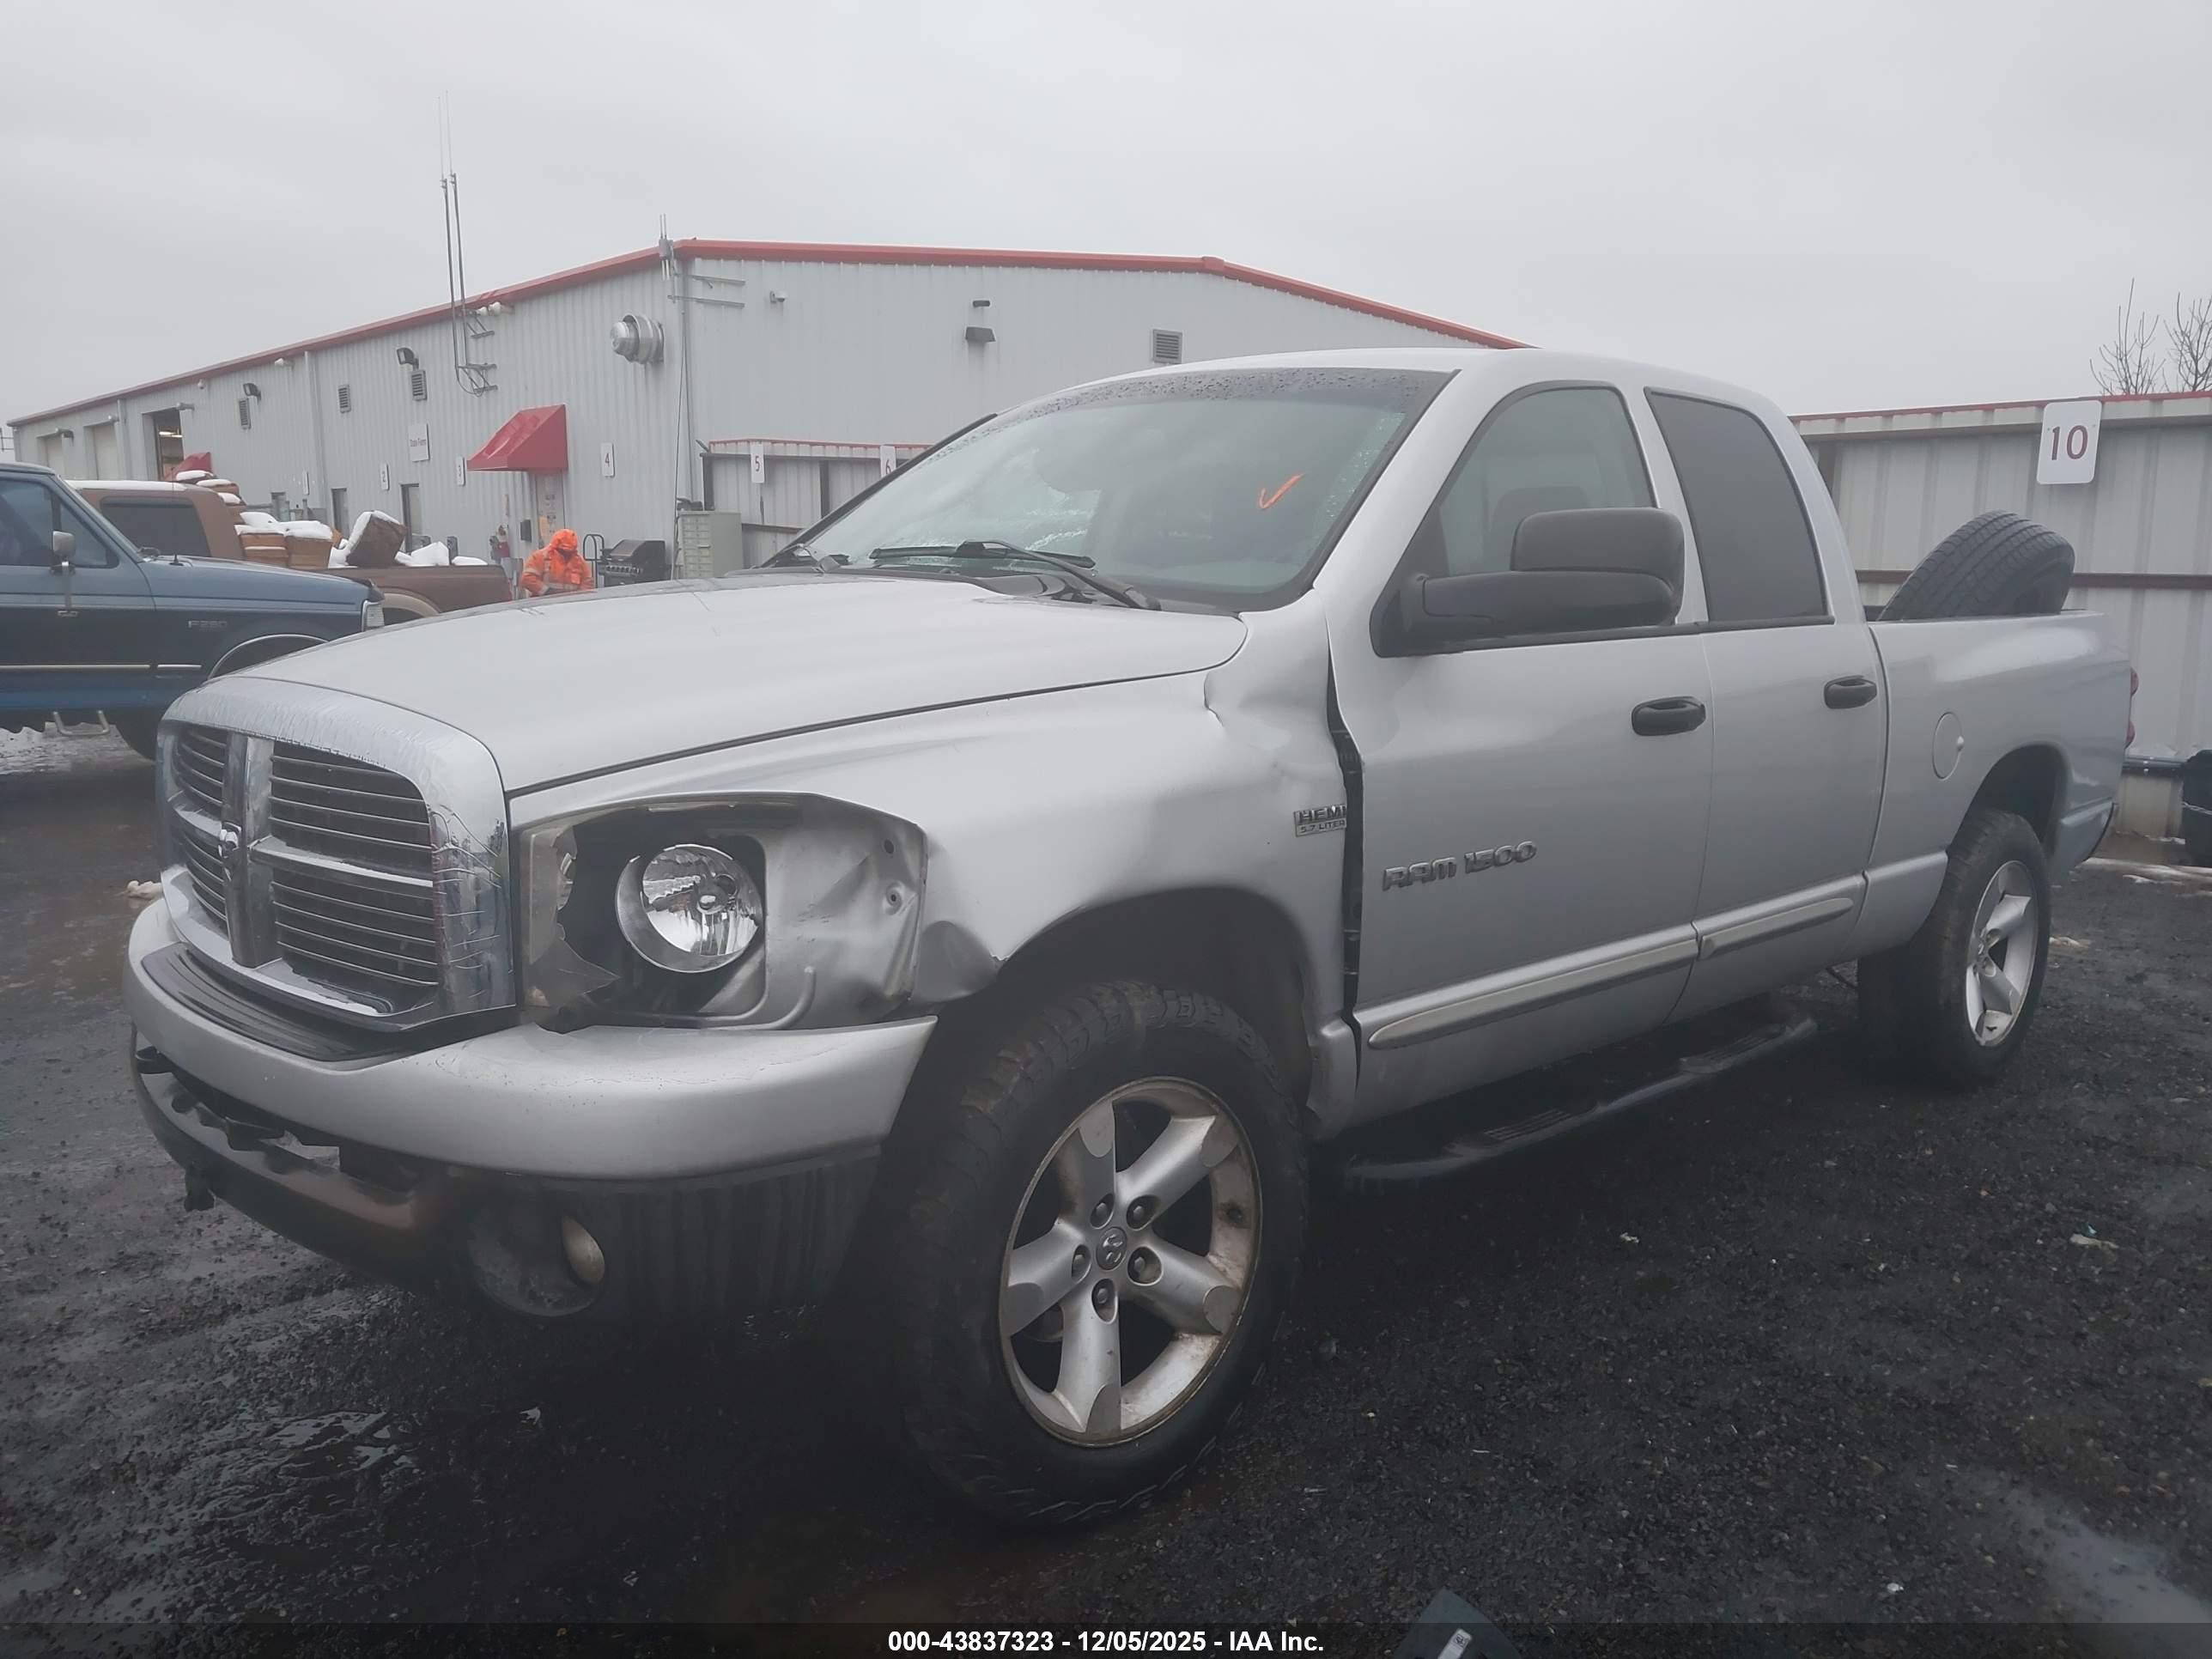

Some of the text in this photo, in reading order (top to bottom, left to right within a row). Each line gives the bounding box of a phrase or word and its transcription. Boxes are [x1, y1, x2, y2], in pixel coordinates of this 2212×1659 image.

[2051, 424, 2088, 461] 10
[605, 453, 611, 468] 4
[755, 455, 761, 472] 5
[885, 459, 892, 475] 6
[1297, 805, 1347, 824] HEMI
[1318, 819, 1346, 830] LITER
[1382, 840, 1538, 892] RAM 1500
